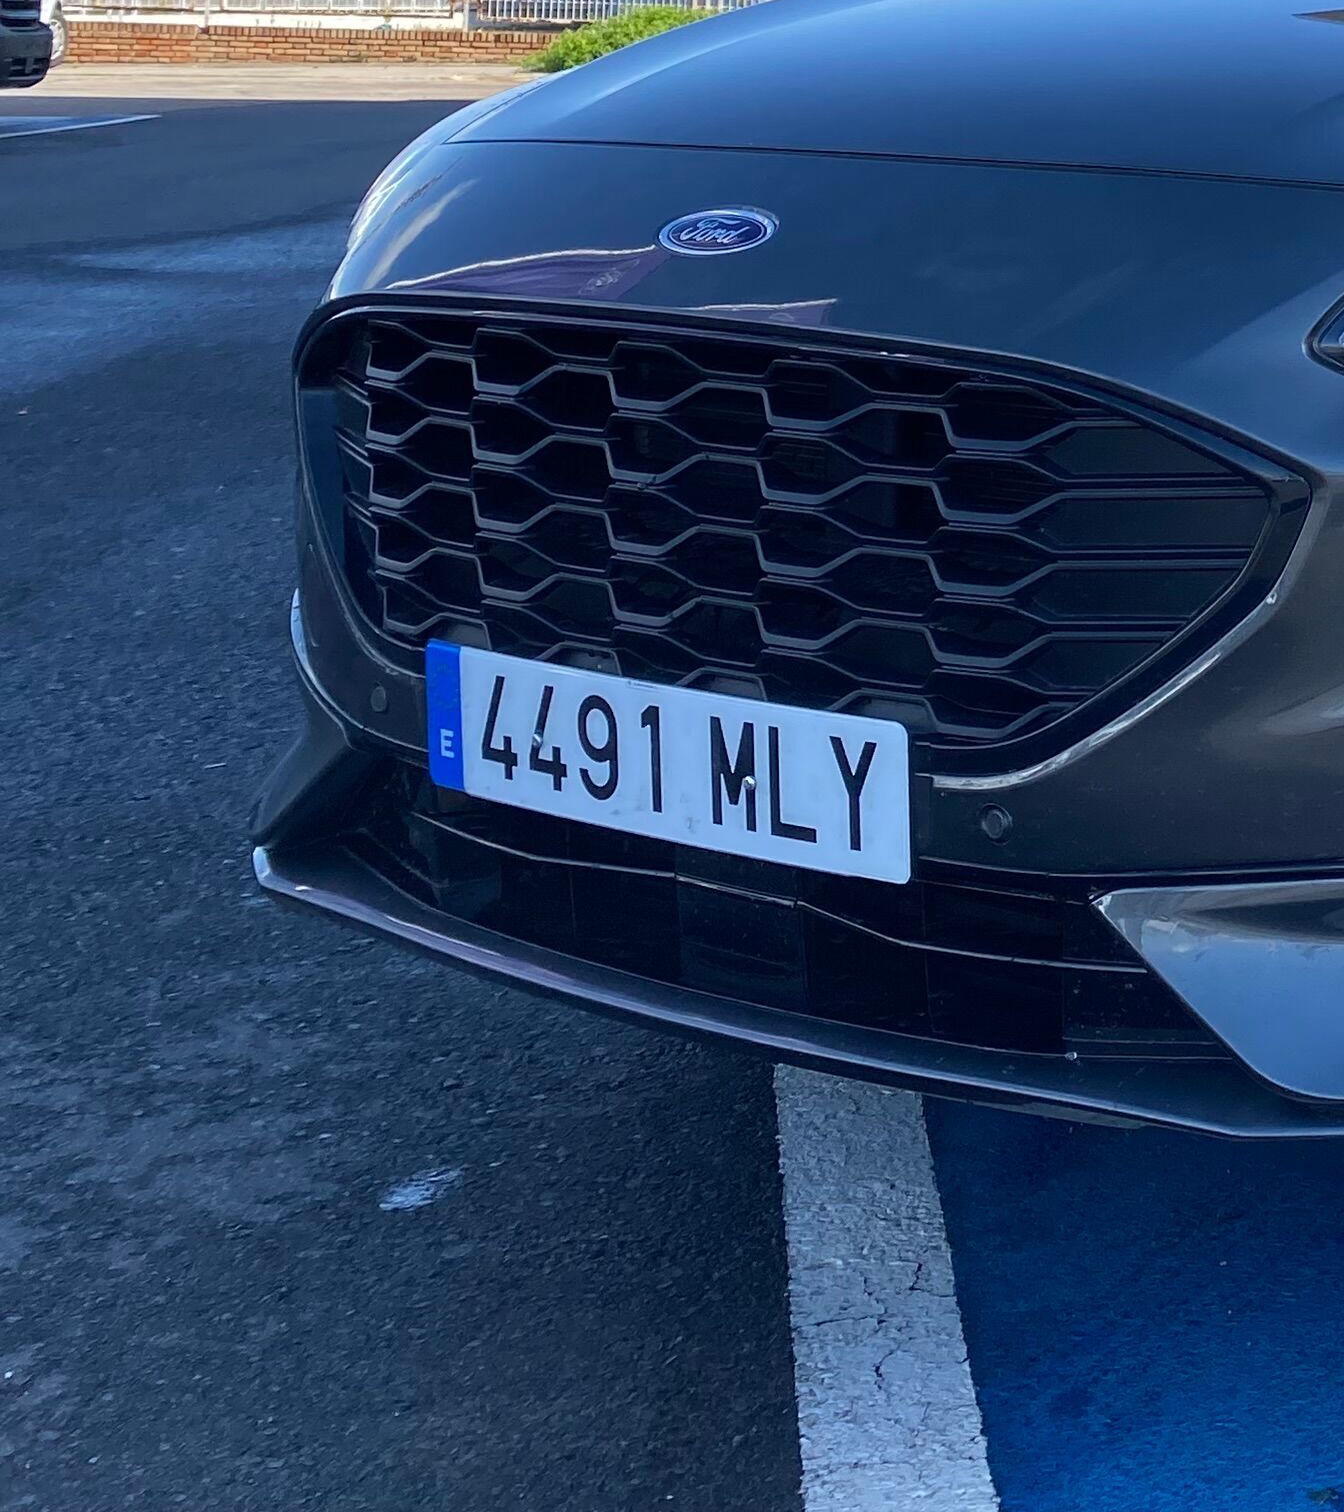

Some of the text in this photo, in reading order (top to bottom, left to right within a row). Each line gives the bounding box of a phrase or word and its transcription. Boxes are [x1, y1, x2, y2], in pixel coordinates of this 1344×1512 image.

[679, 217, 751, 244] Ford
[439, 727, 456, 759] E
[480, 674, 878, 852] 4491 MLY
